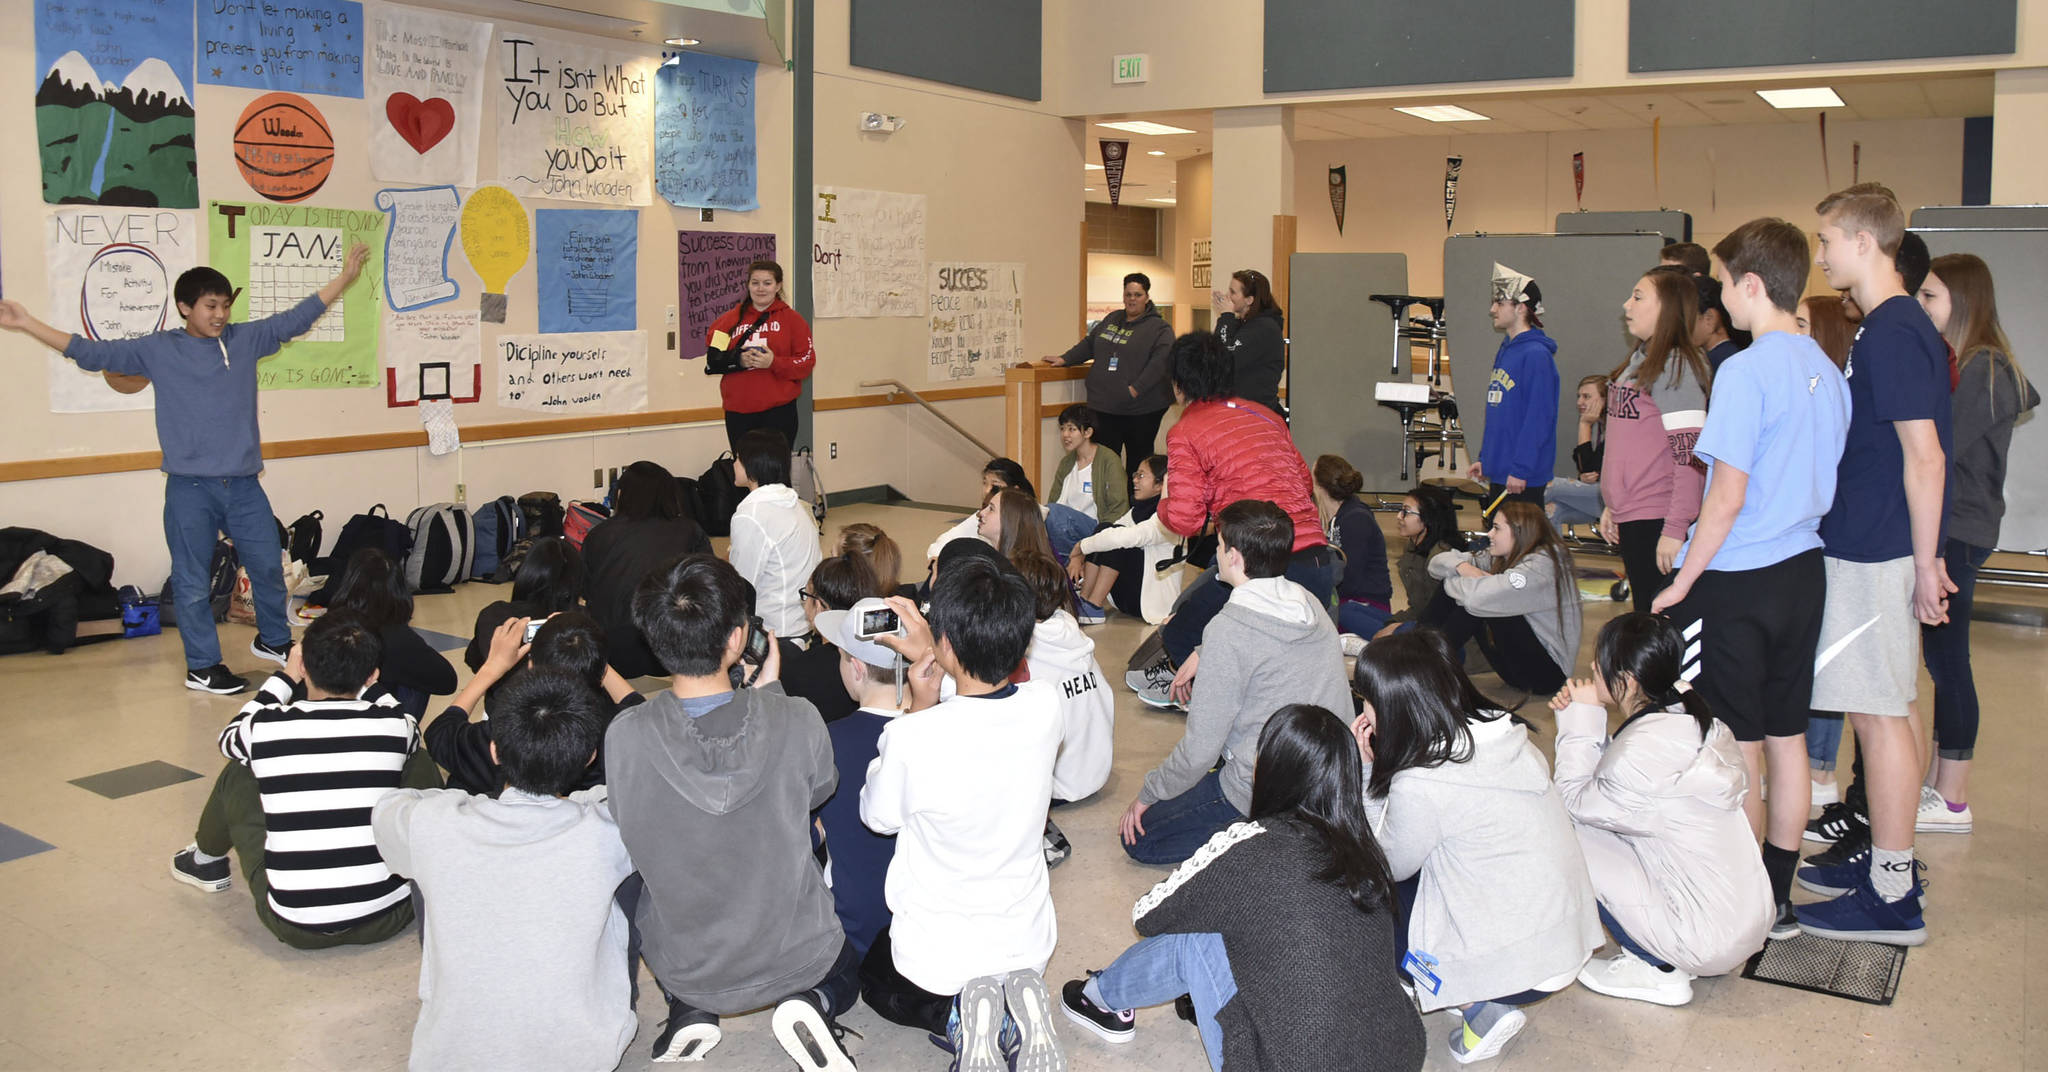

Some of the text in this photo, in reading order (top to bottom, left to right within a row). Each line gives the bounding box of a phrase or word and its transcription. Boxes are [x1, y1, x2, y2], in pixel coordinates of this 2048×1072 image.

[261, 0, 280, 17] let
[285, 6, 332, 28] making
[338, 11, 348, 24] a
[260, 22, 295, 45] living
[206, 40, 361, 74] prevent you from making
[253, 61, 295, 76] a life
[503, 40, 551, 86] It
[604, 64, 645, 95] What
[1119, 57, 1142, 80] EXIT
[565, 92, 588, 114] Do
[594, 91, 627, 118] But
[555, 116, 609, 150] How
[581, 147, 606, 174] Do
[608, 145, 627, 171] it
[543, 174, 582, 199] John
[585, 178, 634, 202] Wooden
[56, 212, 181, 248] NEVER
[303, 206, 321, 227] IS
[325, 208, 346, 229] THE
[346, 210, 386, 233] ONLY
[263, 232, 338, 260] JAN.
[680, 255, 710, 279] from
[938, 267, 988, 292] SUCCESS
[685, 280, 702, 301] you
[704, 271, 721, 290] did
[722, 267, 745, 284] your
[703, 281, 741, 303] become
[688, 305, 711, 327] that
[930, 294, 961, 312] Peace
[560, 349, 608, 366] yourself
[286, 368, 304, 384] IS
[508, 373, 535, 386] and
[608, 367, 633, 378] need
[1062, 671, 1098, 700] HEAD
